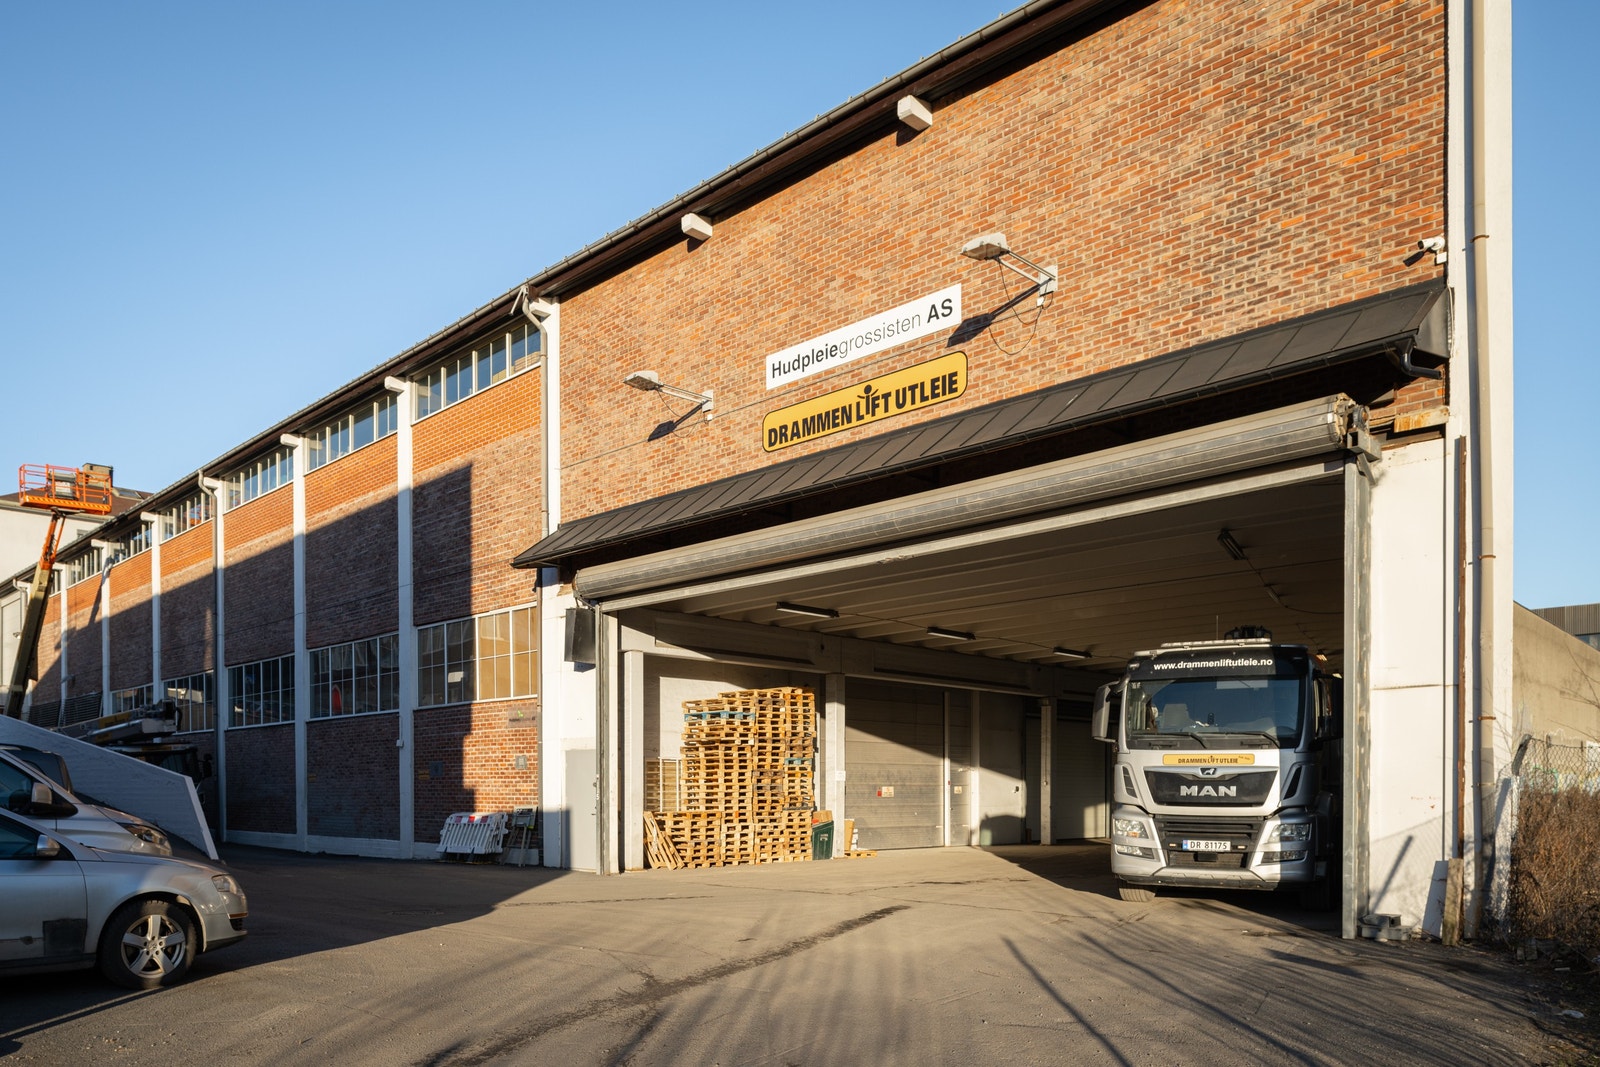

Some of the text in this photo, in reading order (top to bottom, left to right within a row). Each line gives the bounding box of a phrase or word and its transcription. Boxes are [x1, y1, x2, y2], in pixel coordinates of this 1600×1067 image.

[771, 298, 953, 379] Hudpleiegrossisten AS
[768, 403, 852, 448] DRAMMEN
[895, 371, 959, 410] UTLEIE
[1153, 658, 1273, 670] www.drammenliftutleie.no
[1179, 785, 1237, 797] MAN
[1190, 841, 1227, 850] DR 81175
